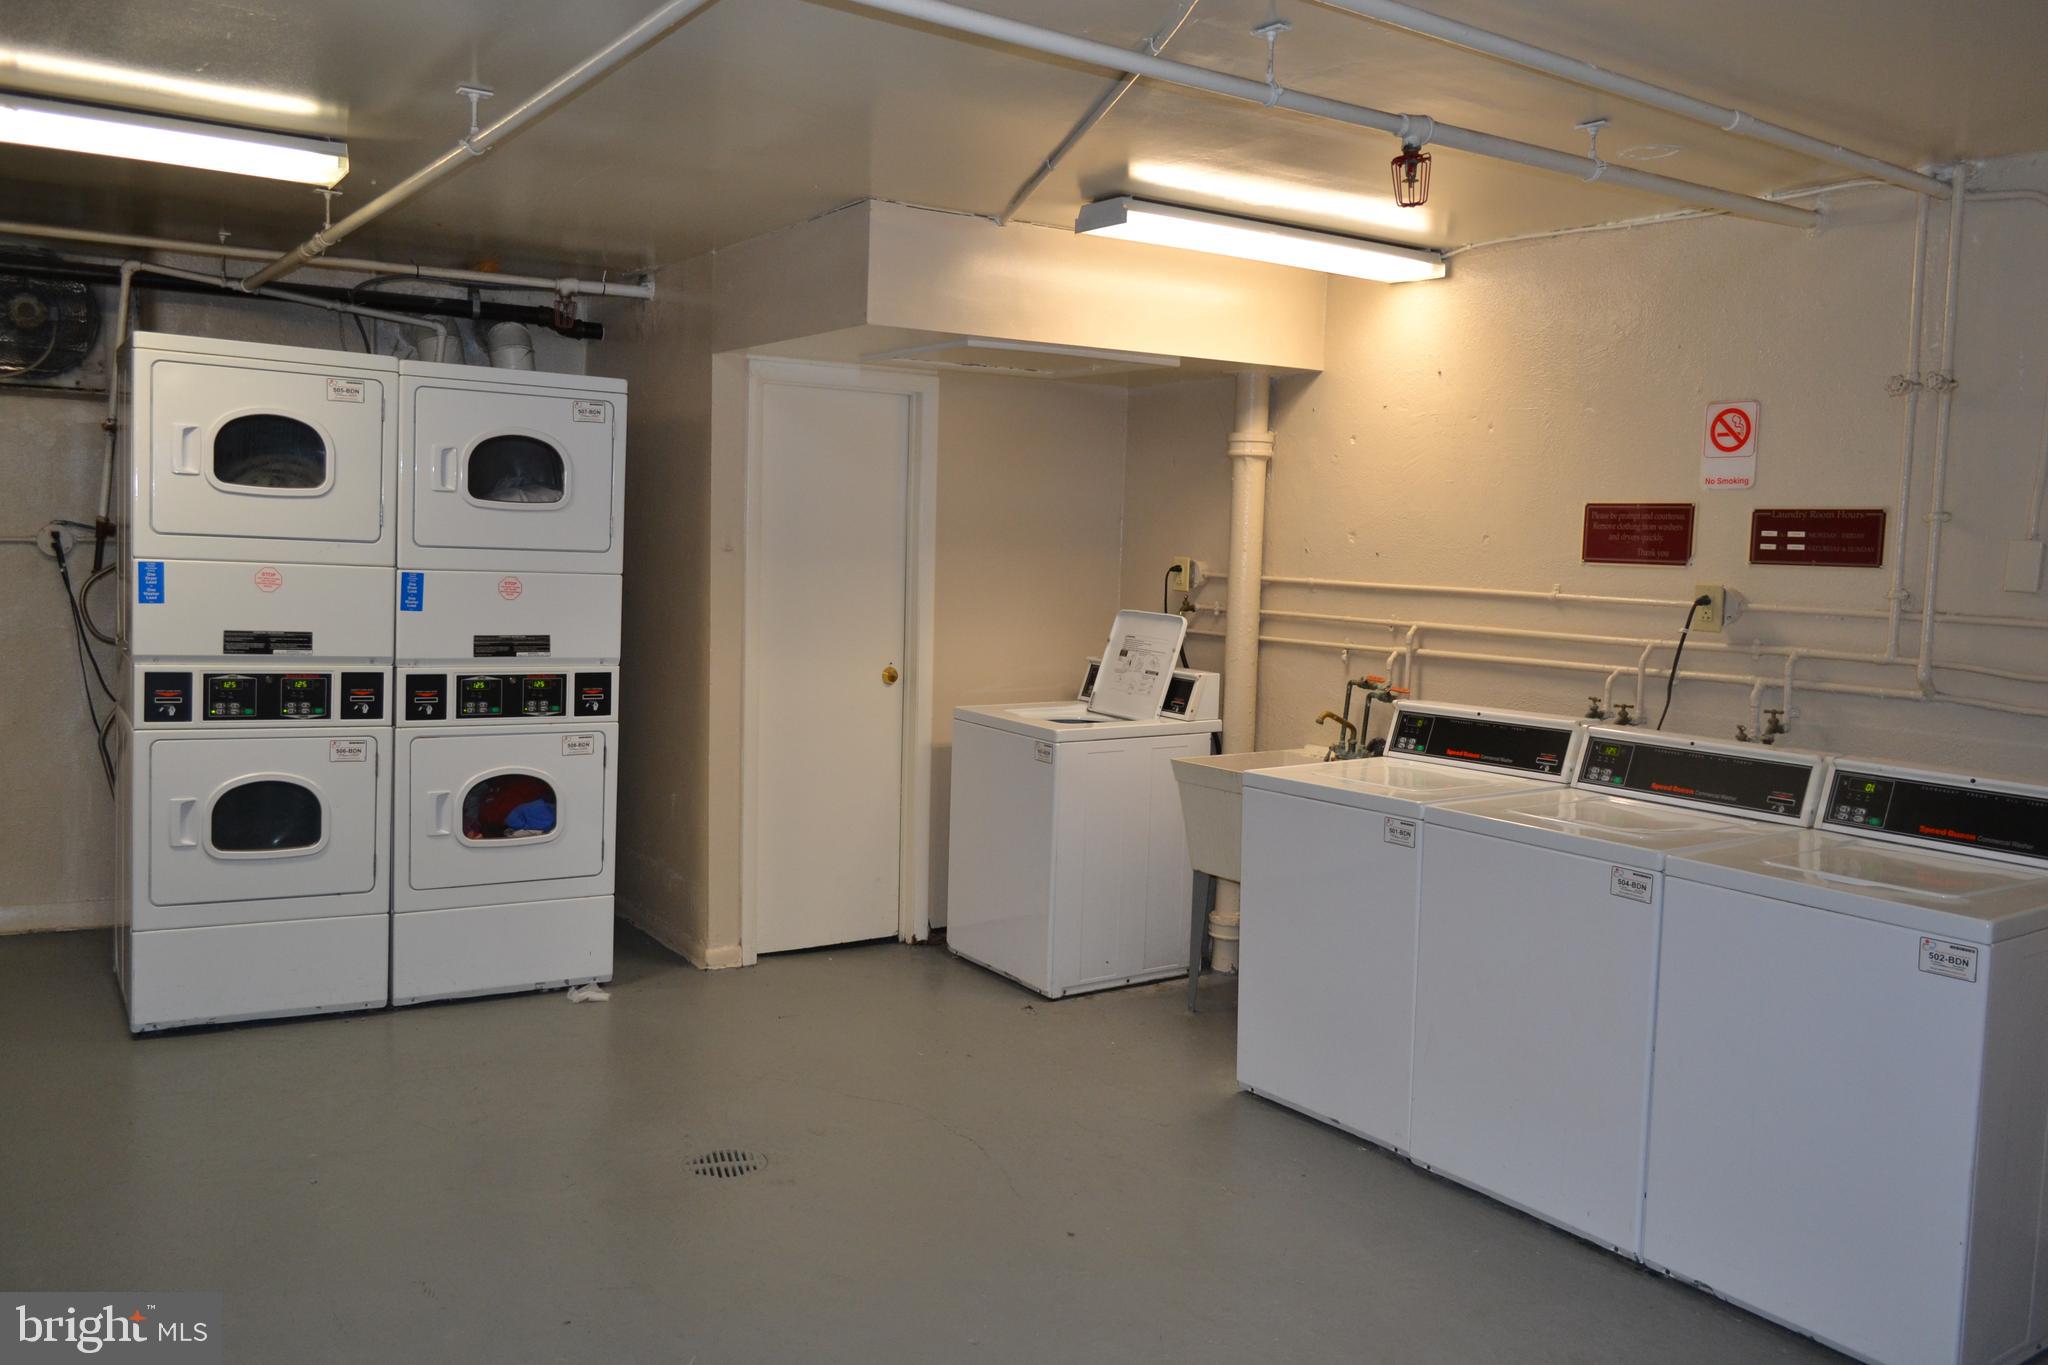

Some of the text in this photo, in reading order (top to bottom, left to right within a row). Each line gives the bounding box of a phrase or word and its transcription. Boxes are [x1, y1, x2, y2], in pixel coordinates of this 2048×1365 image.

[1705, 477, 1749, 486] No Smoking
[1771, 510, 1864, 520] Laundry Room Hours
[1651, 782, 1672, 791] Speed
[1919, 825, 1946, 836] Speed
[1617, 878, 1647, 891] 504-BDN
[1928, 951, 1969, 967] 502-BDN
